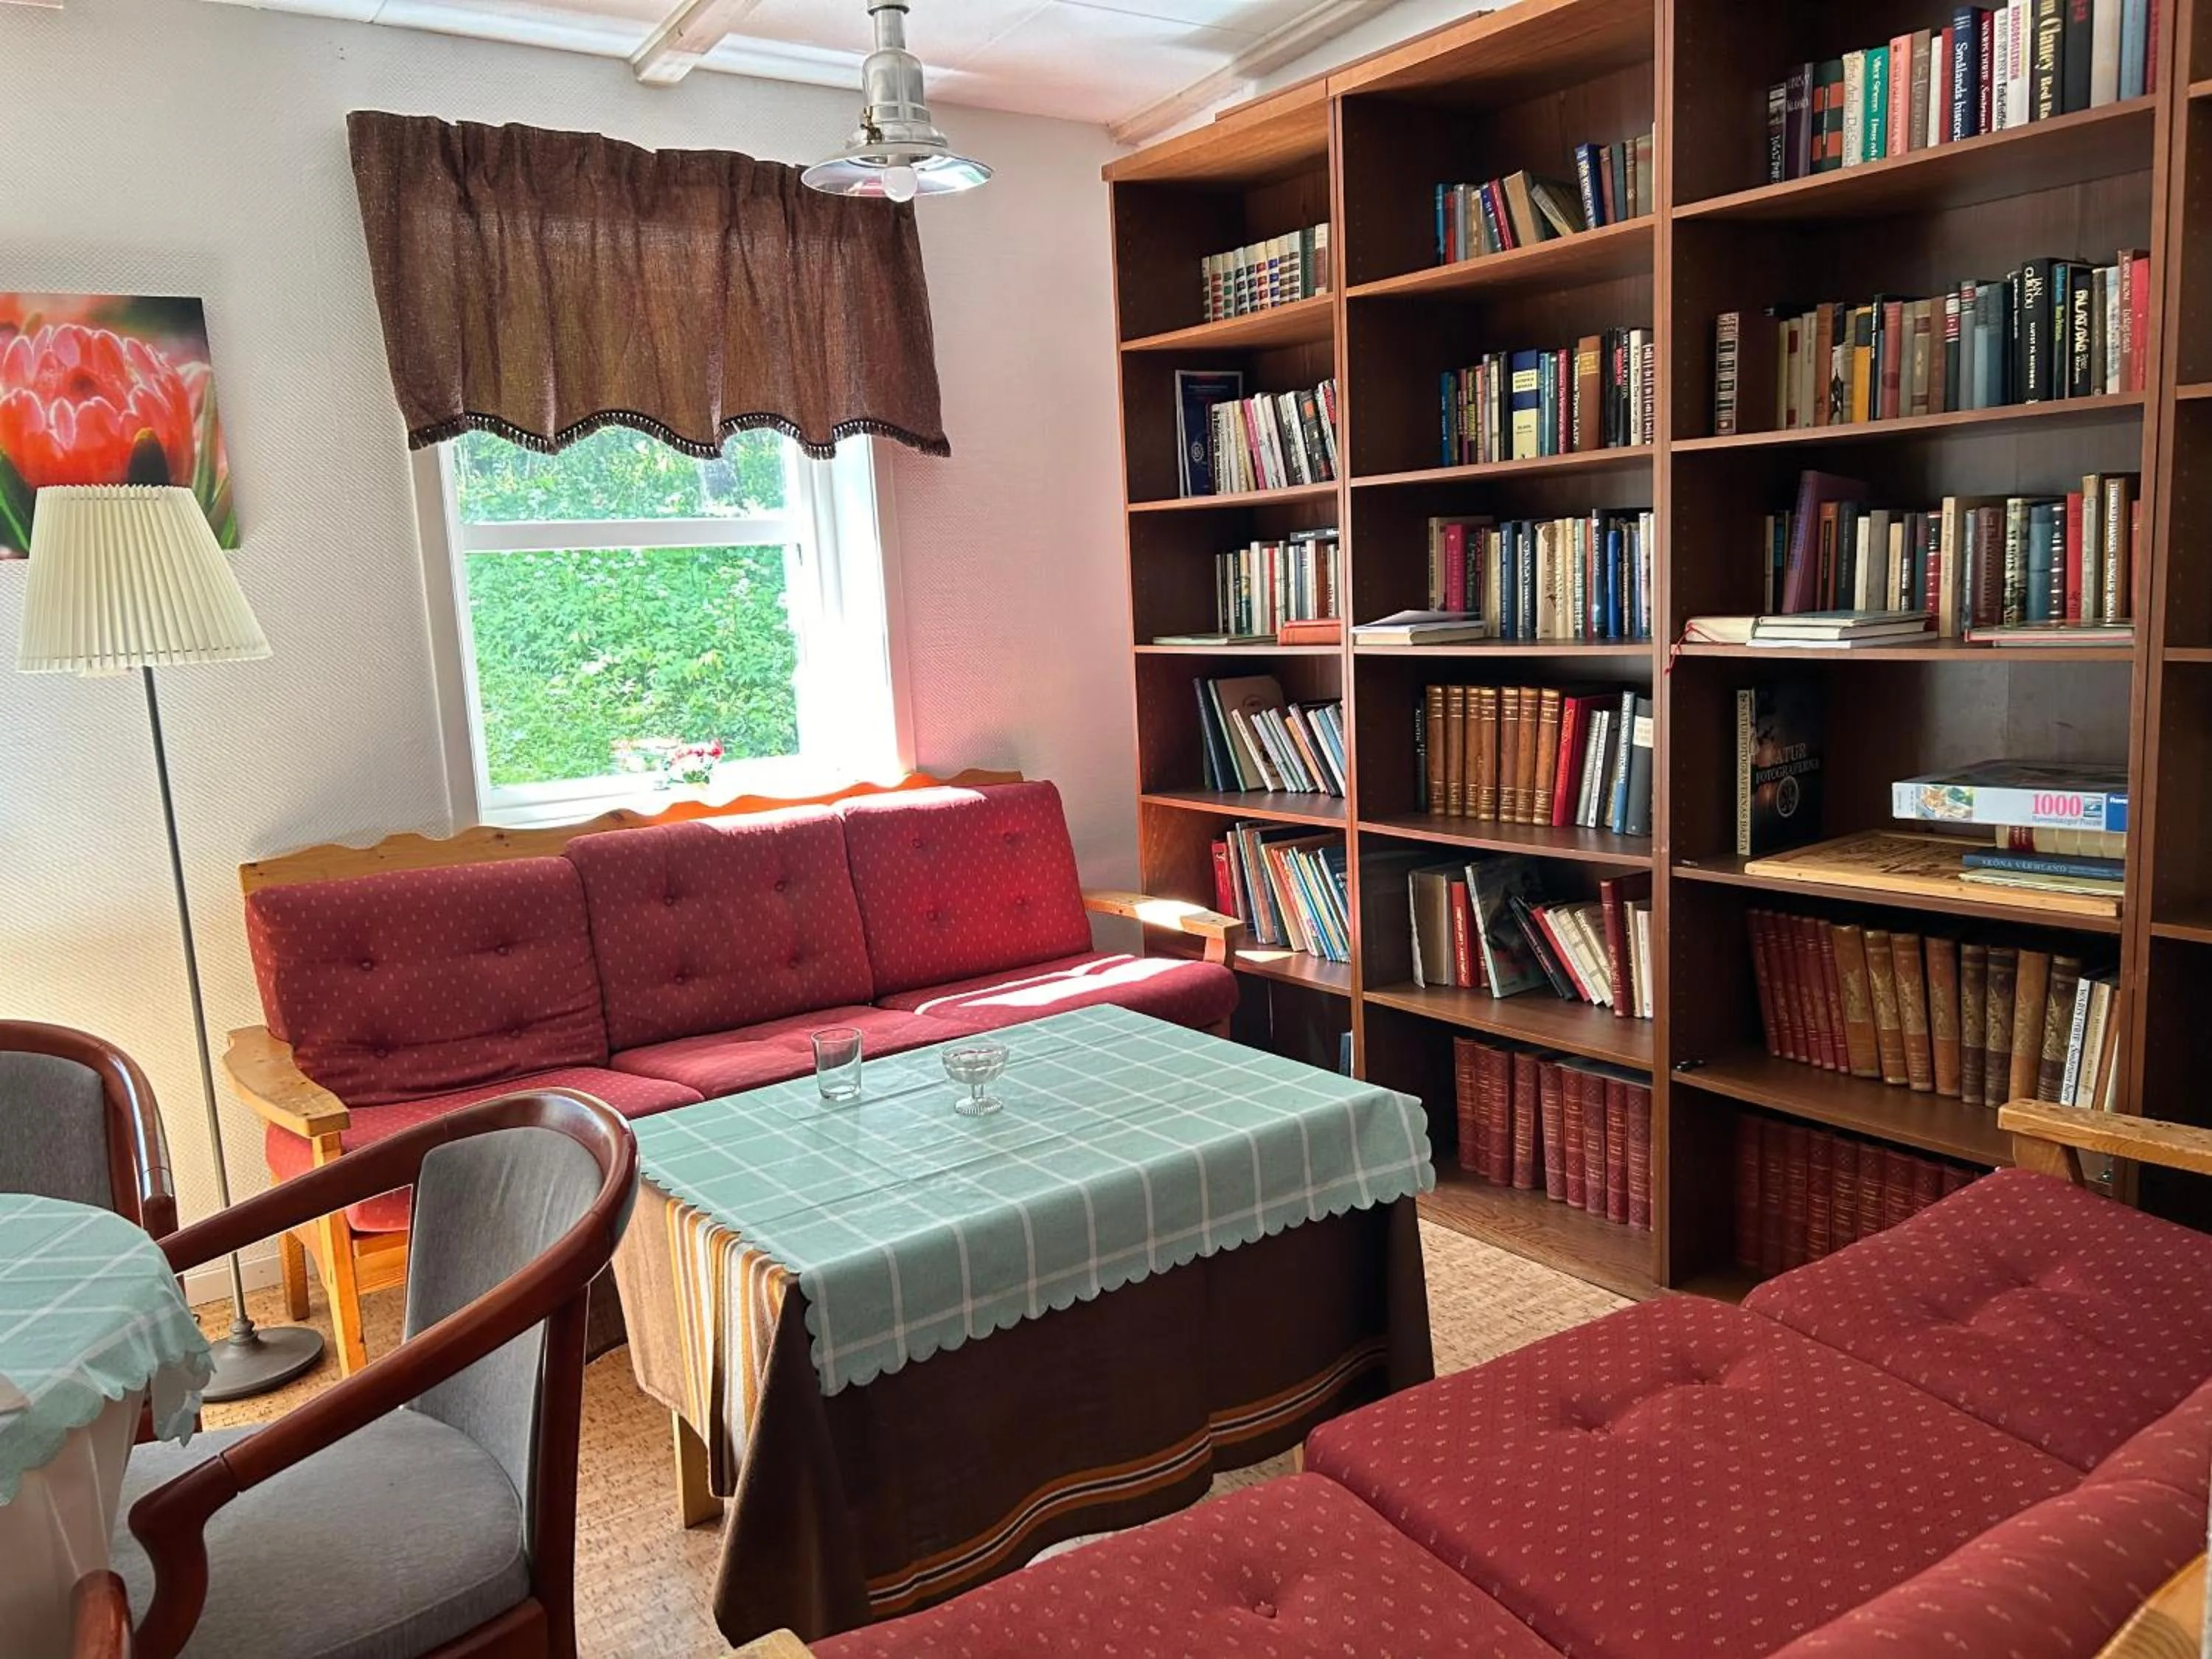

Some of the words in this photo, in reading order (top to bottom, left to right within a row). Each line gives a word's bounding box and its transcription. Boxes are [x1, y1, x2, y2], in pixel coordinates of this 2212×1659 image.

[1954, 41, 1969, 100] Smålands
[2039, 76, 2053, 100] Red
[2033, 277, 2044, 296] JAN
[2032, 793, 2082, 817] 1000
